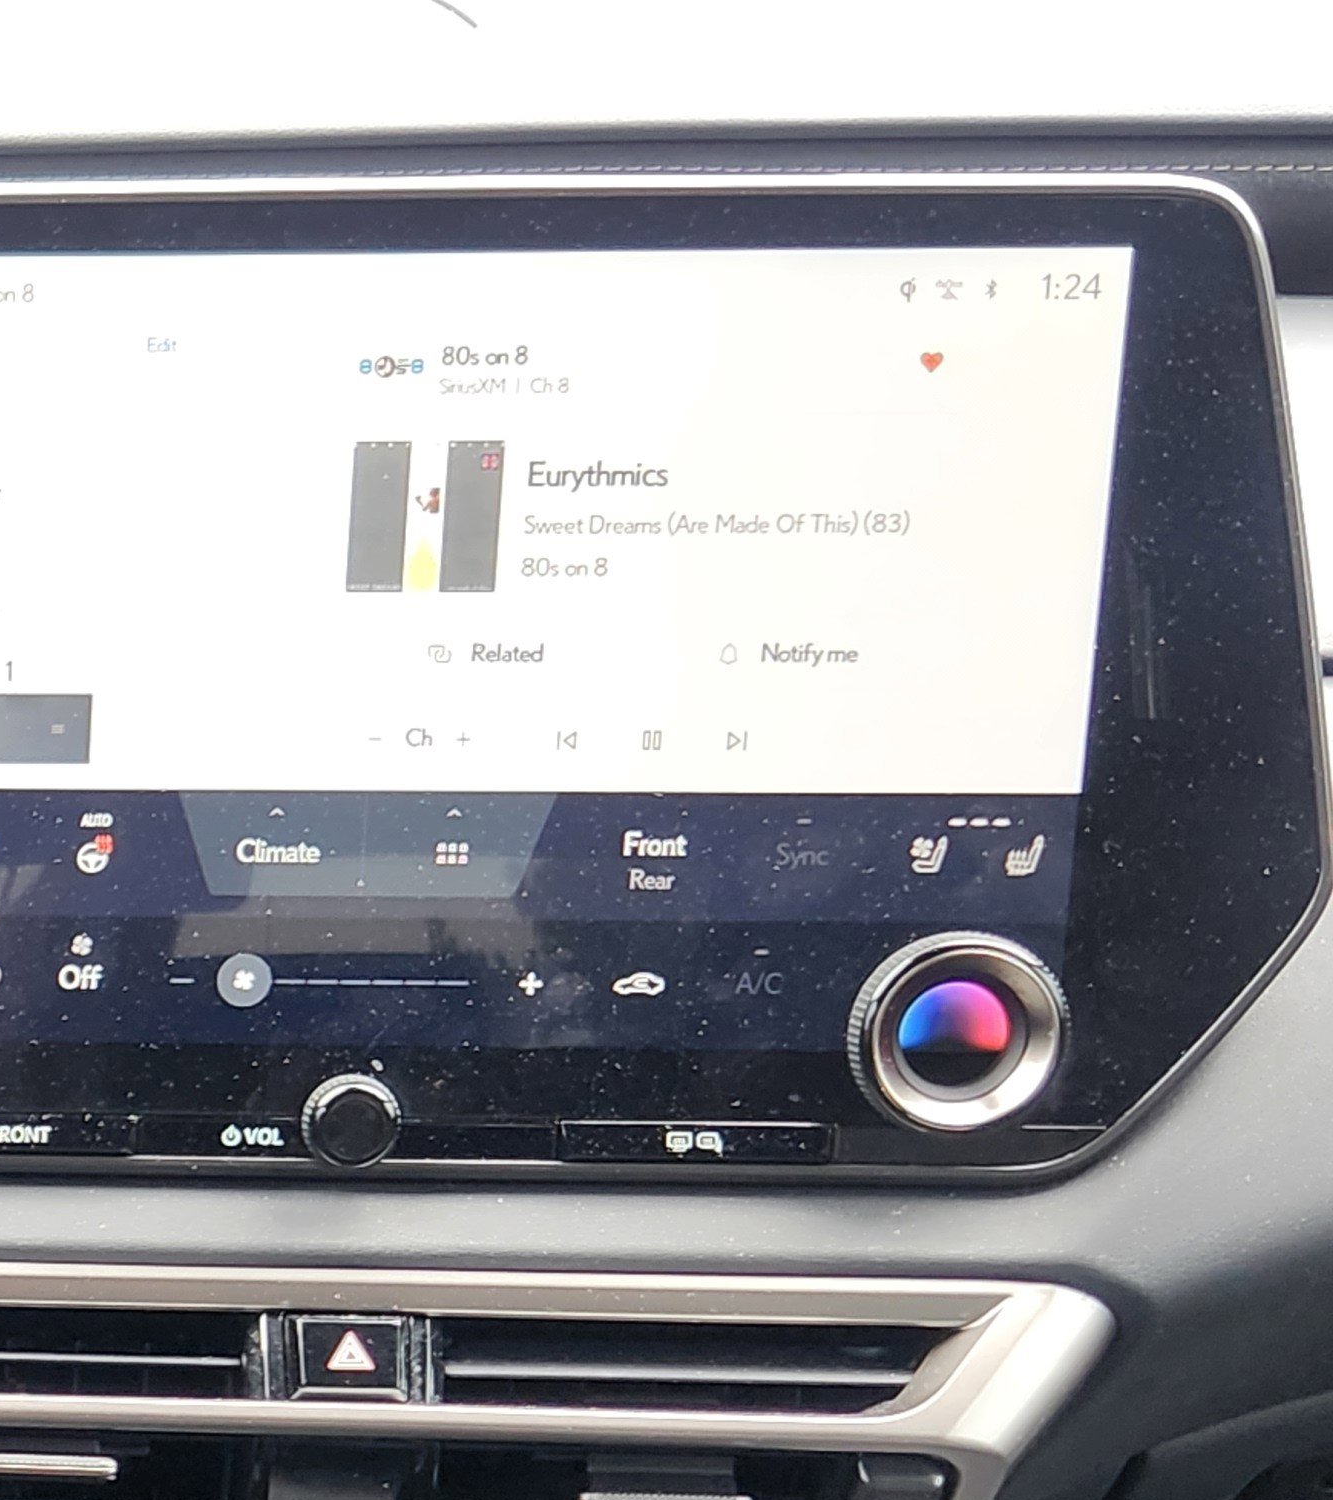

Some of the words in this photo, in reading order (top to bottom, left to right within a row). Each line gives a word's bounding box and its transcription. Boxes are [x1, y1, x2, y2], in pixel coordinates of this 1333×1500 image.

[22, 283, 34, 303] 8
[1042, 273, 1101, 300] 1:24
[442, 345, 479, 366] 80s
[485, 352, 509, 366] on
[515, 345, 528, 366] 8
[438, 378, 506, 395] SiriusXM
[530, 378, 553, 394] Ch
[557, 377, 569, 394] 8
[528, 459, 669, 493] Eurythmics
[523, 514, 584, 536] Sweet
[589, 514, 662, 536] Dreams
[667, 510, 710, 537] (Are
[715, 513, 771, 535] Made
[775, 513, 807, 535] Of
[812, 510, 859, 537] This)
[863, 510, 912, 537] (83)
[521, 557, 559, 578] 80s
[565, 562, 588, 578] on
[594, 557, 608, 578] 8
[471, 643, 544, 663] Related
[760, 643, 823, 668] Notify
[827, 648, 859, 663] me
[6, 660, 14, 682] 1
[405, 727, 433, 747] Ch
[79, 812, 113, 829] AUTO
[236, 837, 322, 865] Climate
[623, 830, 689, 857] Front
[776, 843, 830, 869] Sync
[628, 868, 676, 891] Rear
[57, 964, 105, 992] Off
[735, 972, 784, 996] A/C
[243, 1126, 285, 1147] VOL
